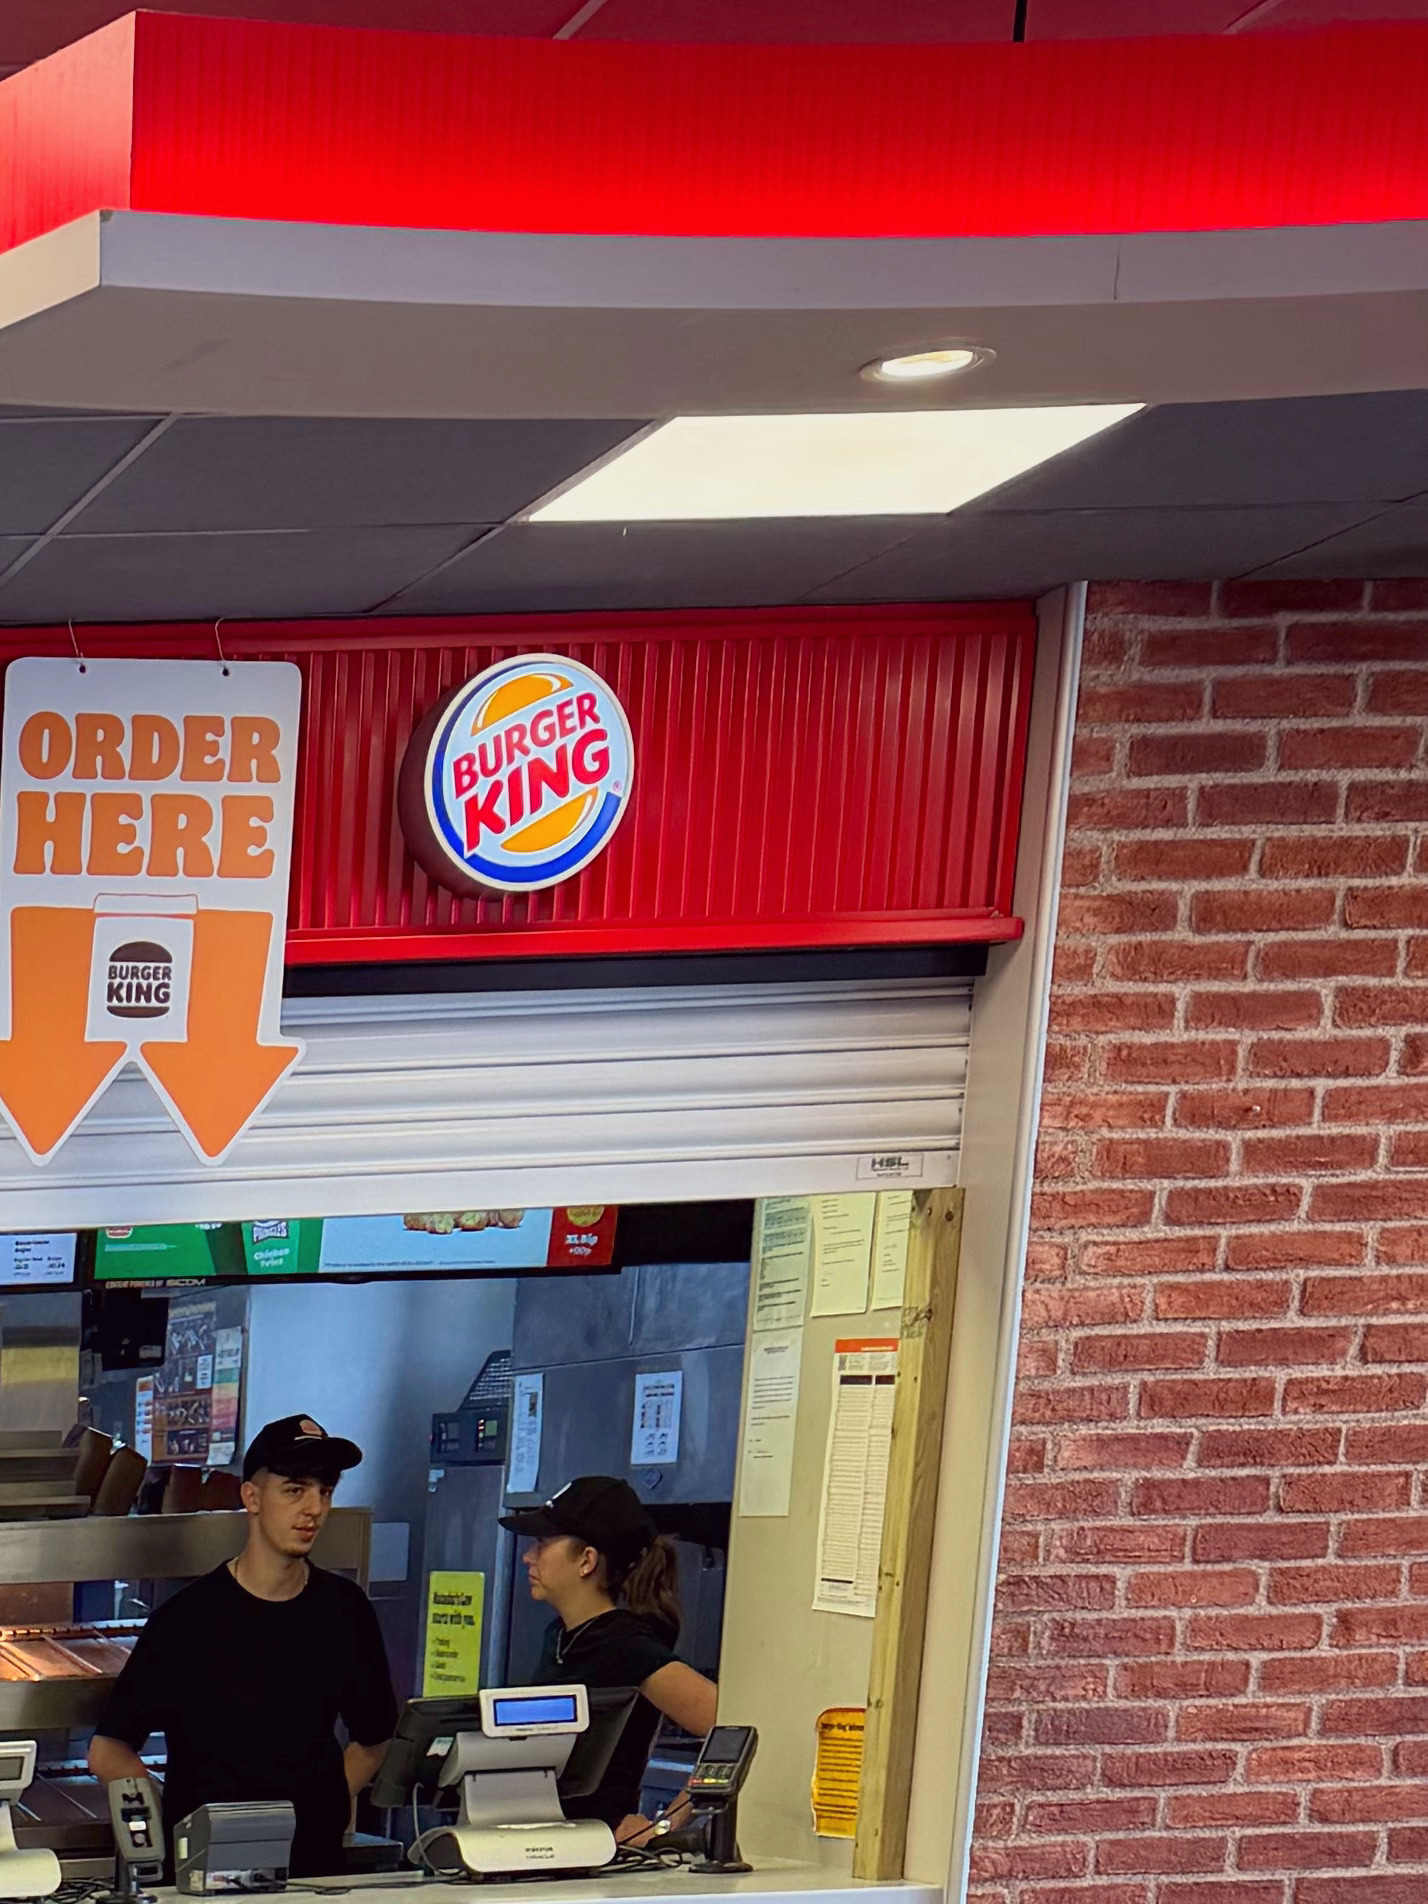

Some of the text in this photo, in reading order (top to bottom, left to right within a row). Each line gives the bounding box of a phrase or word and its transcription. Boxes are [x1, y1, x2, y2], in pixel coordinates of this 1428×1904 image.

[18, 711, 281, 783] ORDER
[453, 692, 601, 799] BURGER
[464, 728, 610, 852] KING
[13, 791, 275, 878] HERE
[107, 965, 172, 981] BURGER
[107, 982, 171, 1003] KING
